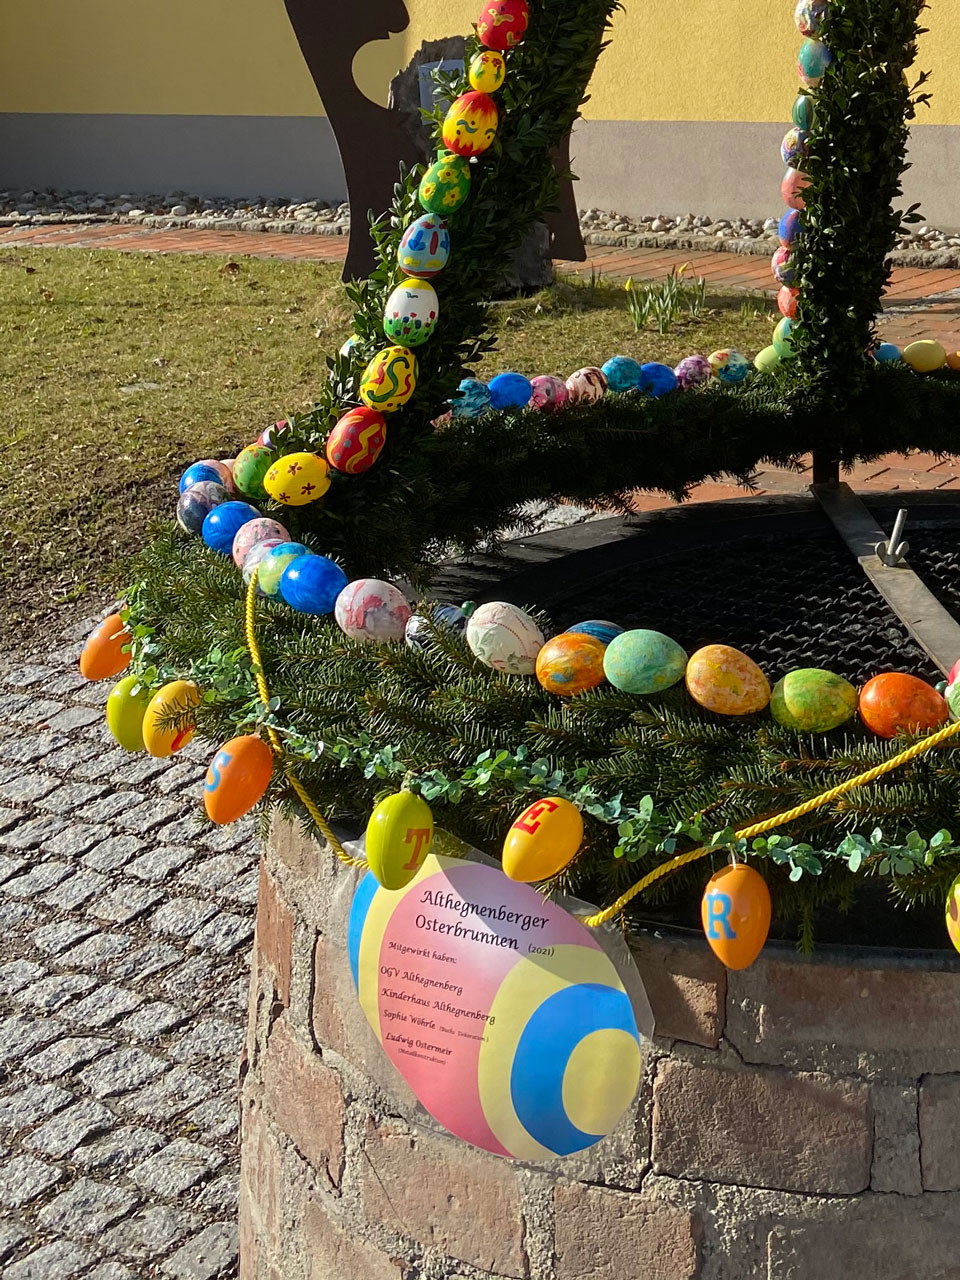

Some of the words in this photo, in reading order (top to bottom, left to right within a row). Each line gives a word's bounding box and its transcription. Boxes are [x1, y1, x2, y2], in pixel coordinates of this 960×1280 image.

[420, 890, 550, 931] Althegnenberger
[415, 914, 519, 950] Osterbrunnen
[528, 943, 555, 957] (2021)
[388, 941, 430, 958] Mitgewirkt
[432, 950, 458, 964] haben:
[380, 966, 400, 978] OGV
[401, 971, 463, 996] Althegnenberg
[381, 988, 431, 1007] Kinderhaus
[432, 1000, 496, 1025] Althegnenberg
[383, 1009, 408, 1022] Sophie
[409, 1014, 436, 1030] Wöhrle
[385, 1032, 414, 1047] Ludwig
